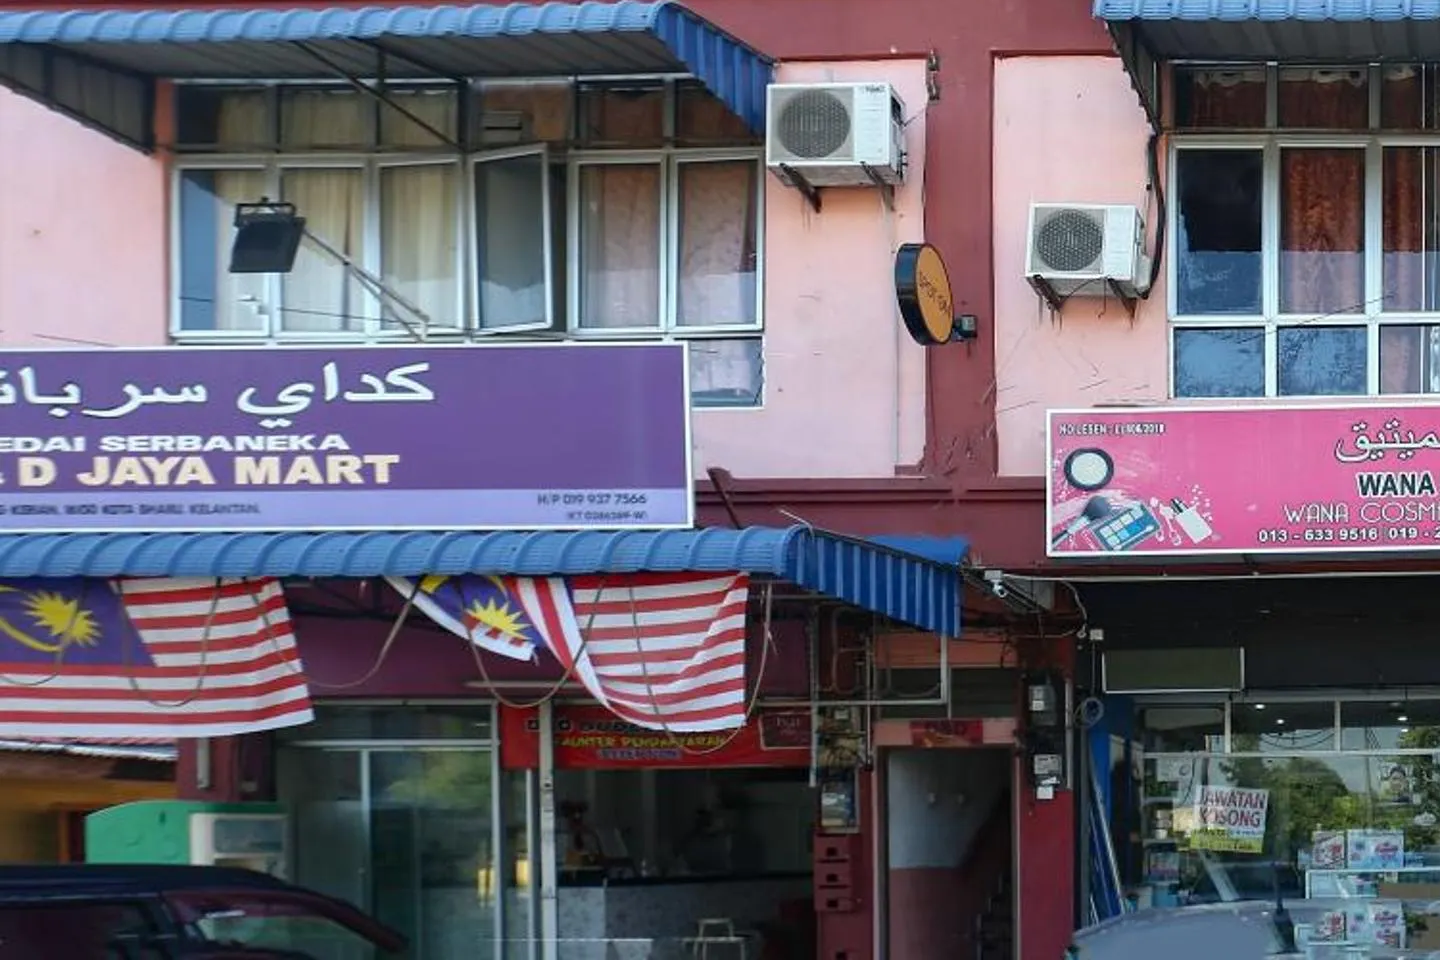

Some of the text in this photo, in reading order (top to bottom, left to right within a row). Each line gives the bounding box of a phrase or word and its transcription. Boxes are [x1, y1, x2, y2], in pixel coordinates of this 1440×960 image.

[99, 434, 350, 452] SERBANEKA
[18, 457, 56, 486] D
[76, 456, 216, 486] JAYA
[233, 454, 400, 485] MART
[1357, 472, 1436, 497] WANA
[1283, 503, 1349, 524] WANA
[1258, 529, 1287, 542] 013
[1305, 529, 1333, 541] 633
[1339, 528, 1378, 540] 9516
[1388, 527, 1418, 539] 019
[1201, 788, 1266, 809] JAWATAN
